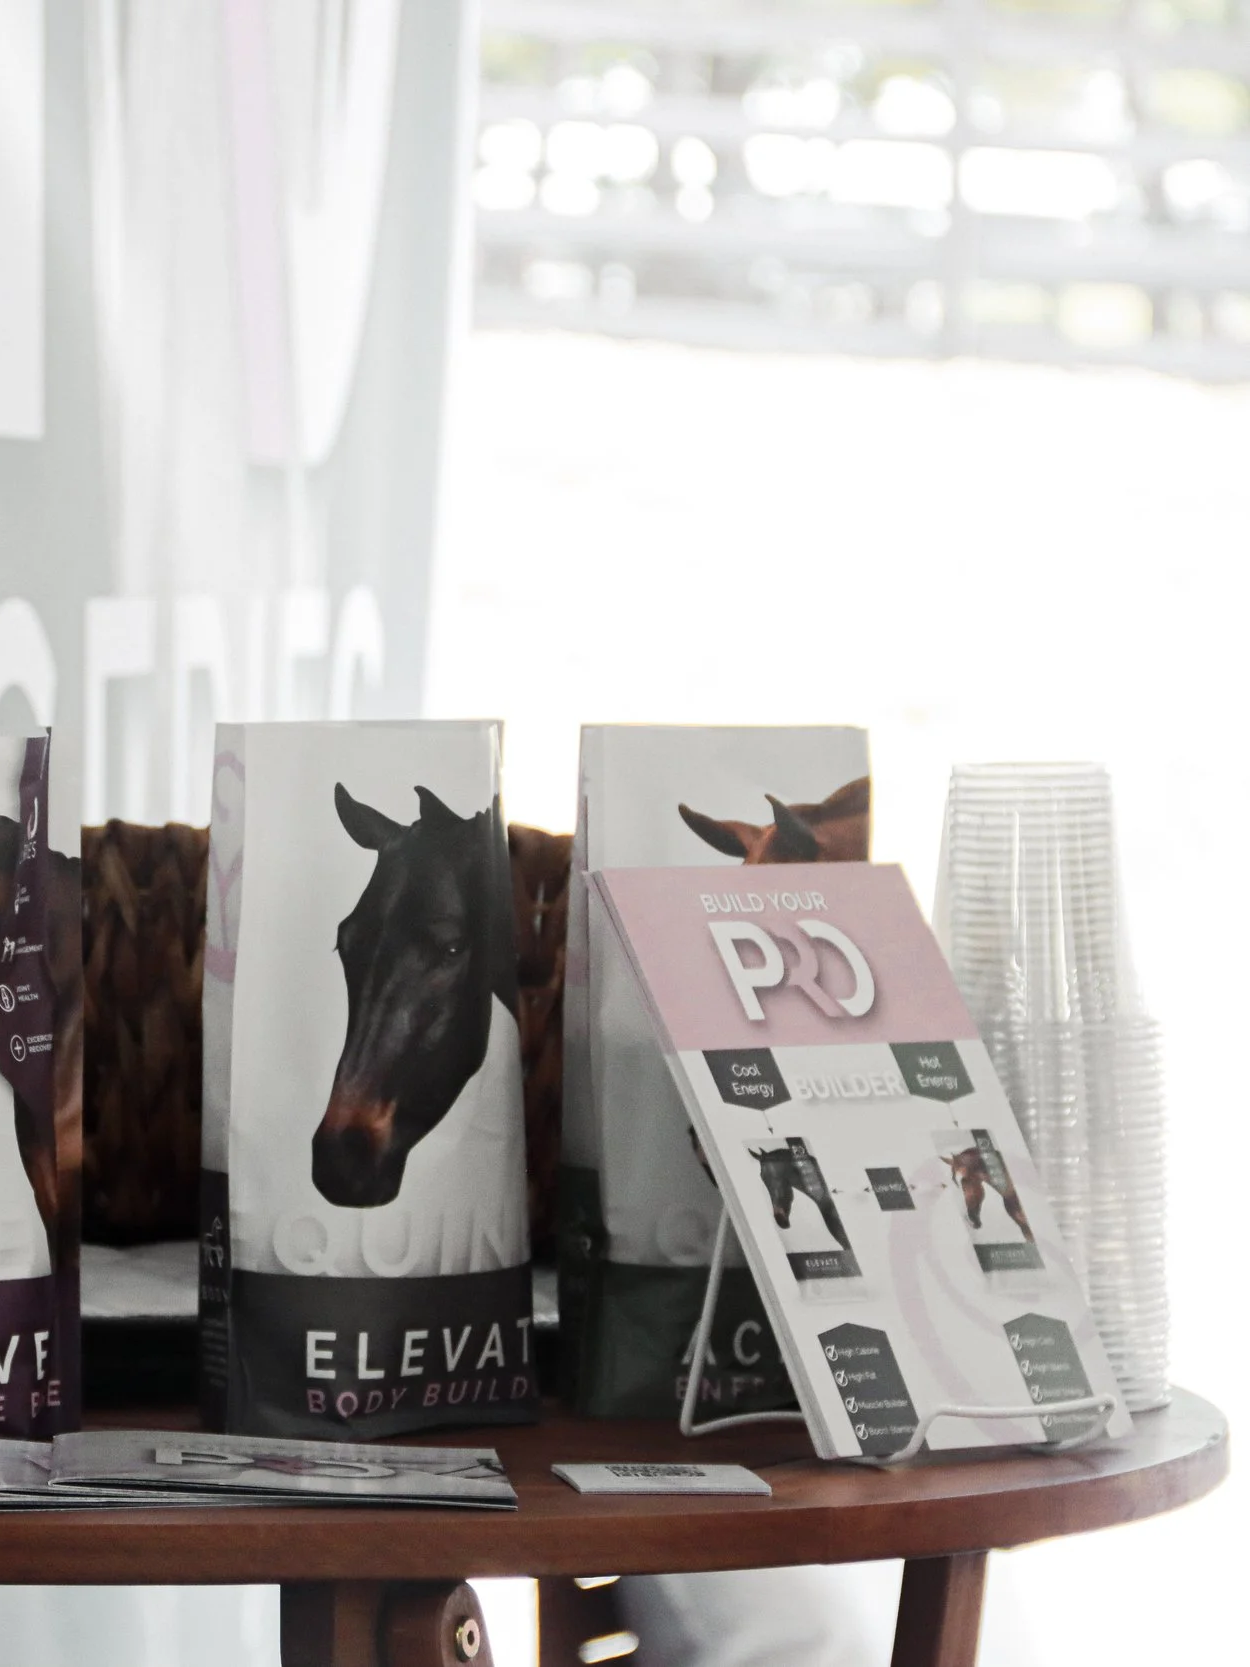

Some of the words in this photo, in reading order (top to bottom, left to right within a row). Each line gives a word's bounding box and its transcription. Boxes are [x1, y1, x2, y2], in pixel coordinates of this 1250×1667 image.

[699, 891, 765, 914] BUILD
[770, 891, 829, 912] YOUR
[707, 919, 875, 1021] PRO
[731, 1062, 761, 1077] Cool
[918, 1056, 942, 1070] Hot
[732, 1081, 775, 1098] Energy
[794, 1071, 906, 1100] BUILDER
[917, 1074, 959, 1091] Energy
[306, 1317, 531, 1380] ELEVAT
[307, 1387, 408, 1419] BODY
